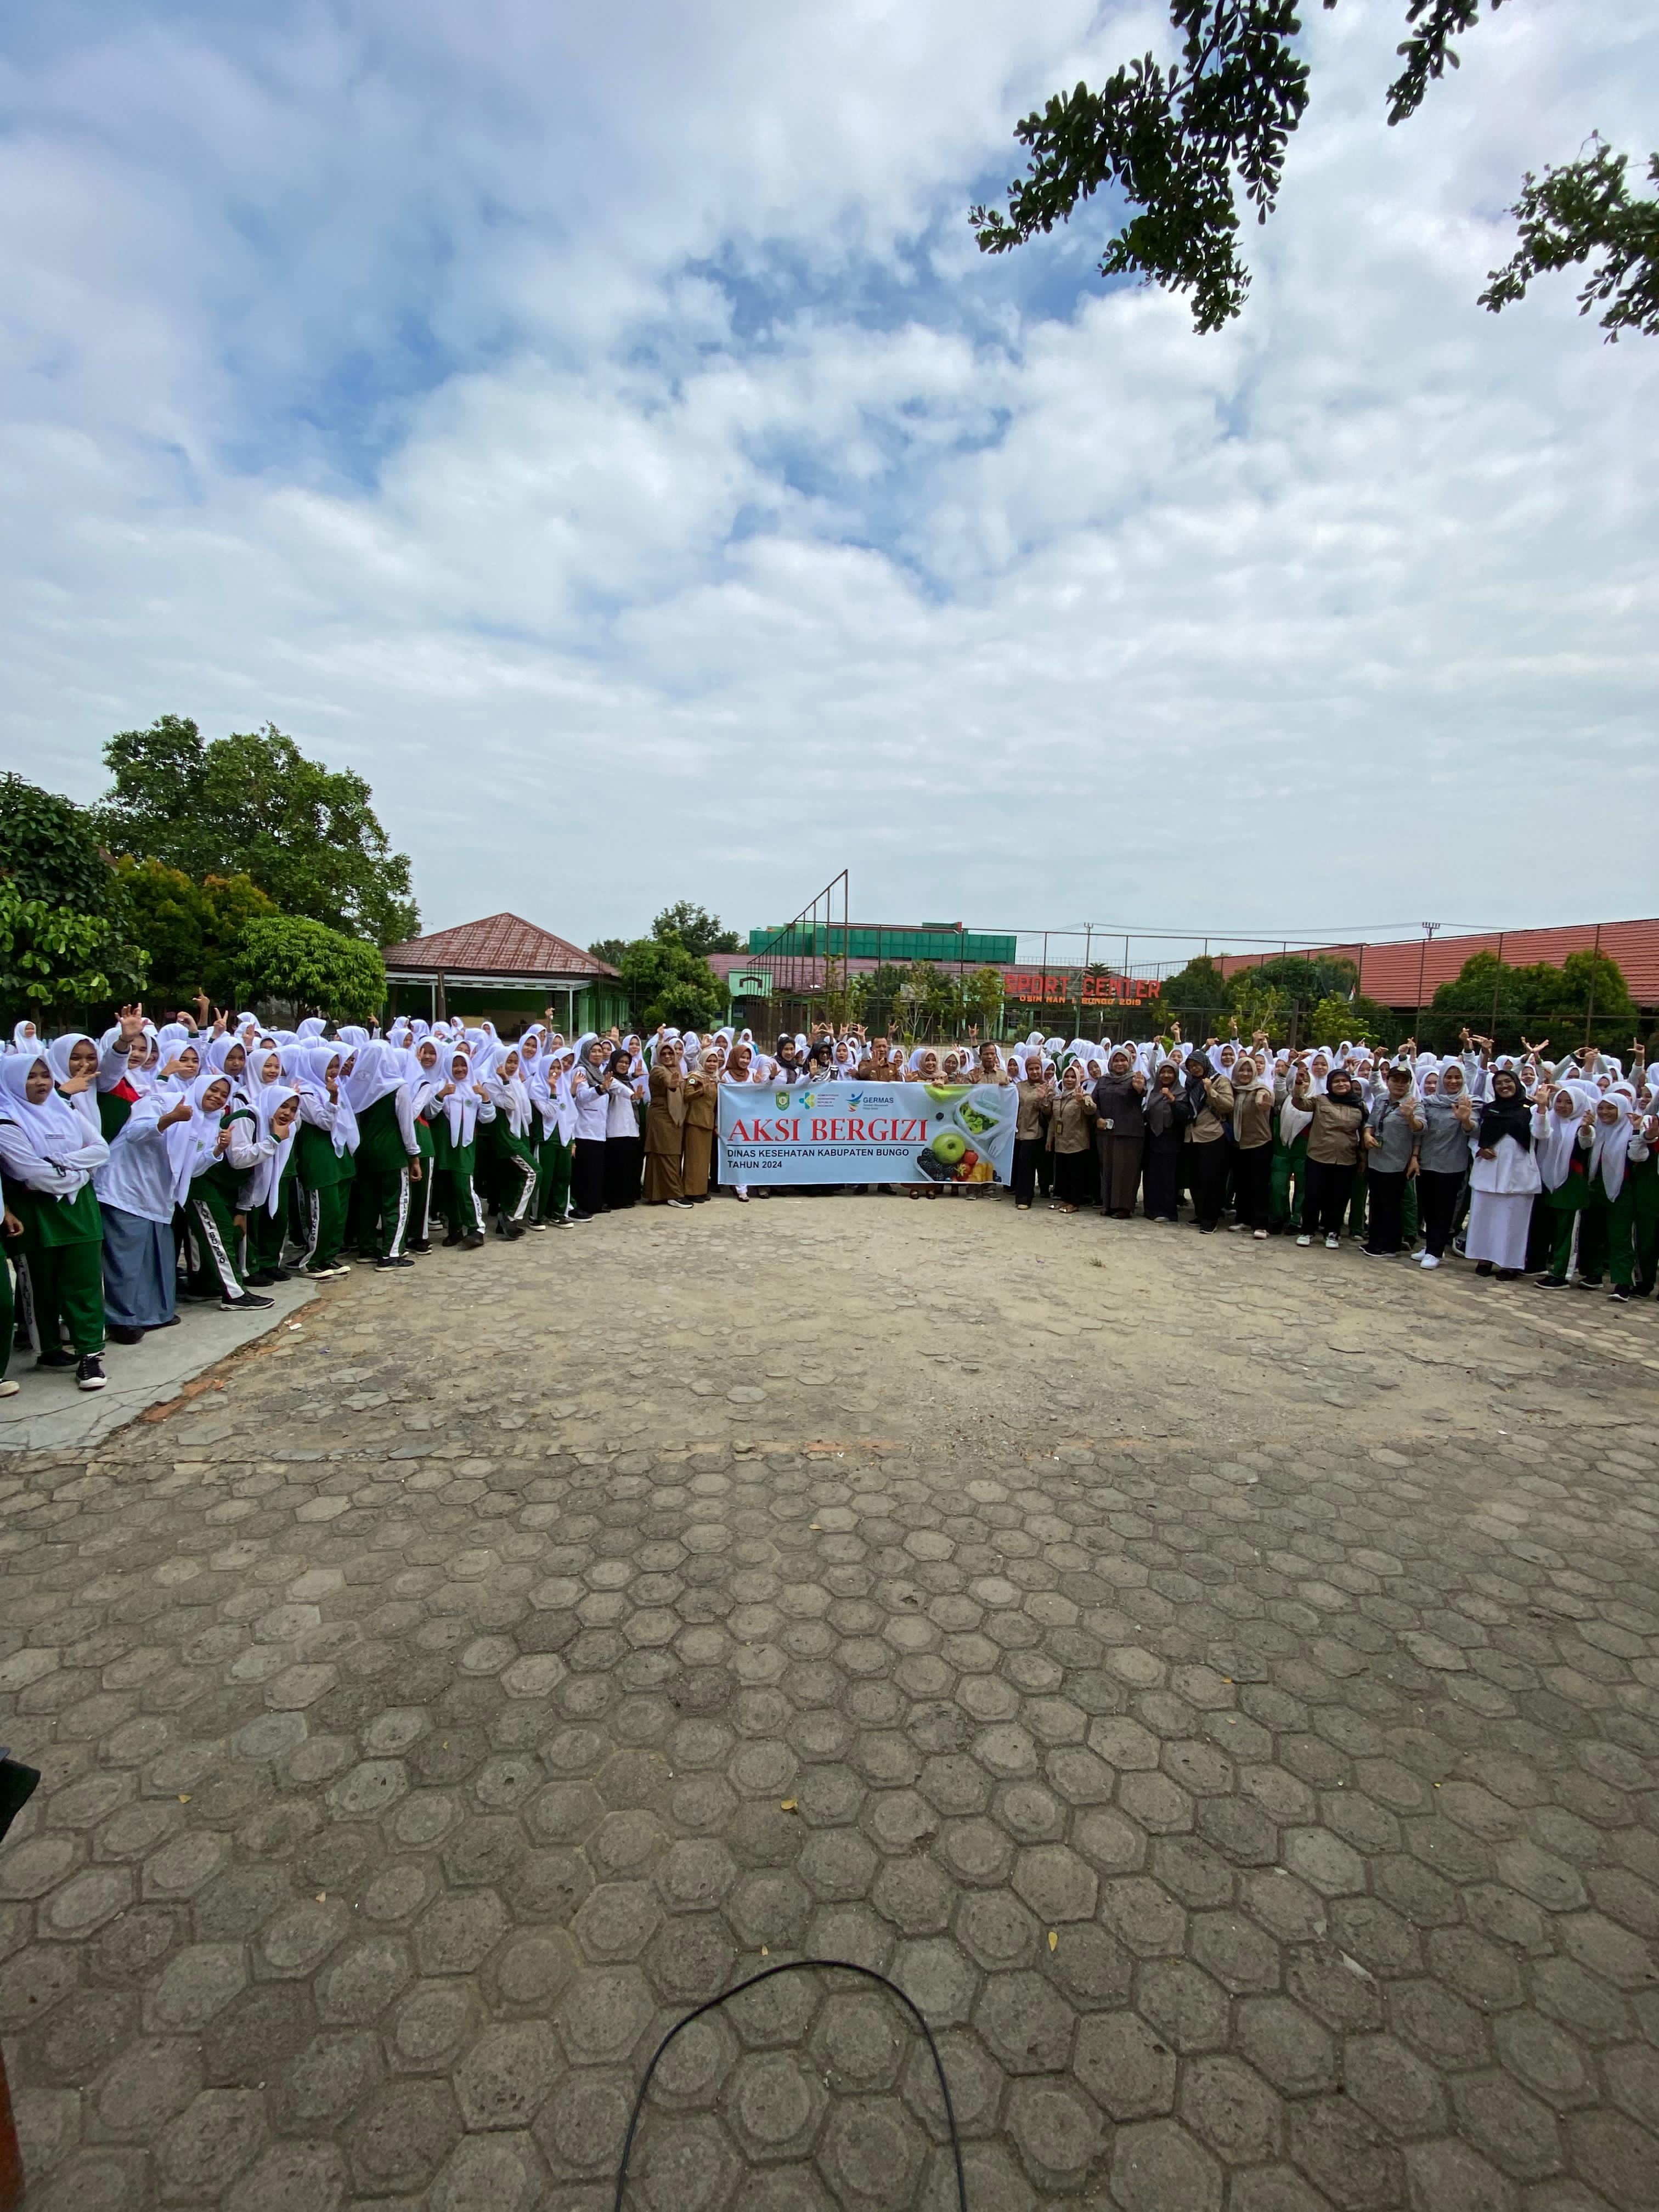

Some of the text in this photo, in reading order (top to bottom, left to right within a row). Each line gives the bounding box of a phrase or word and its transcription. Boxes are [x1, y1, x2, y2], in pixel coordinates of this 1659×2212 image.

[1005, 974, 1161, 998] SPORT CENTER
[727, 1118, 928, 1142] AKSI BERGIZI
[727, 1149, 756, 1158] DINAS
[817, 1149, 873, 1157] KABUPATEN
[727, 1160, 759, 1169] TAHUN
[209, 1232, 225, 1263] BUNGO
